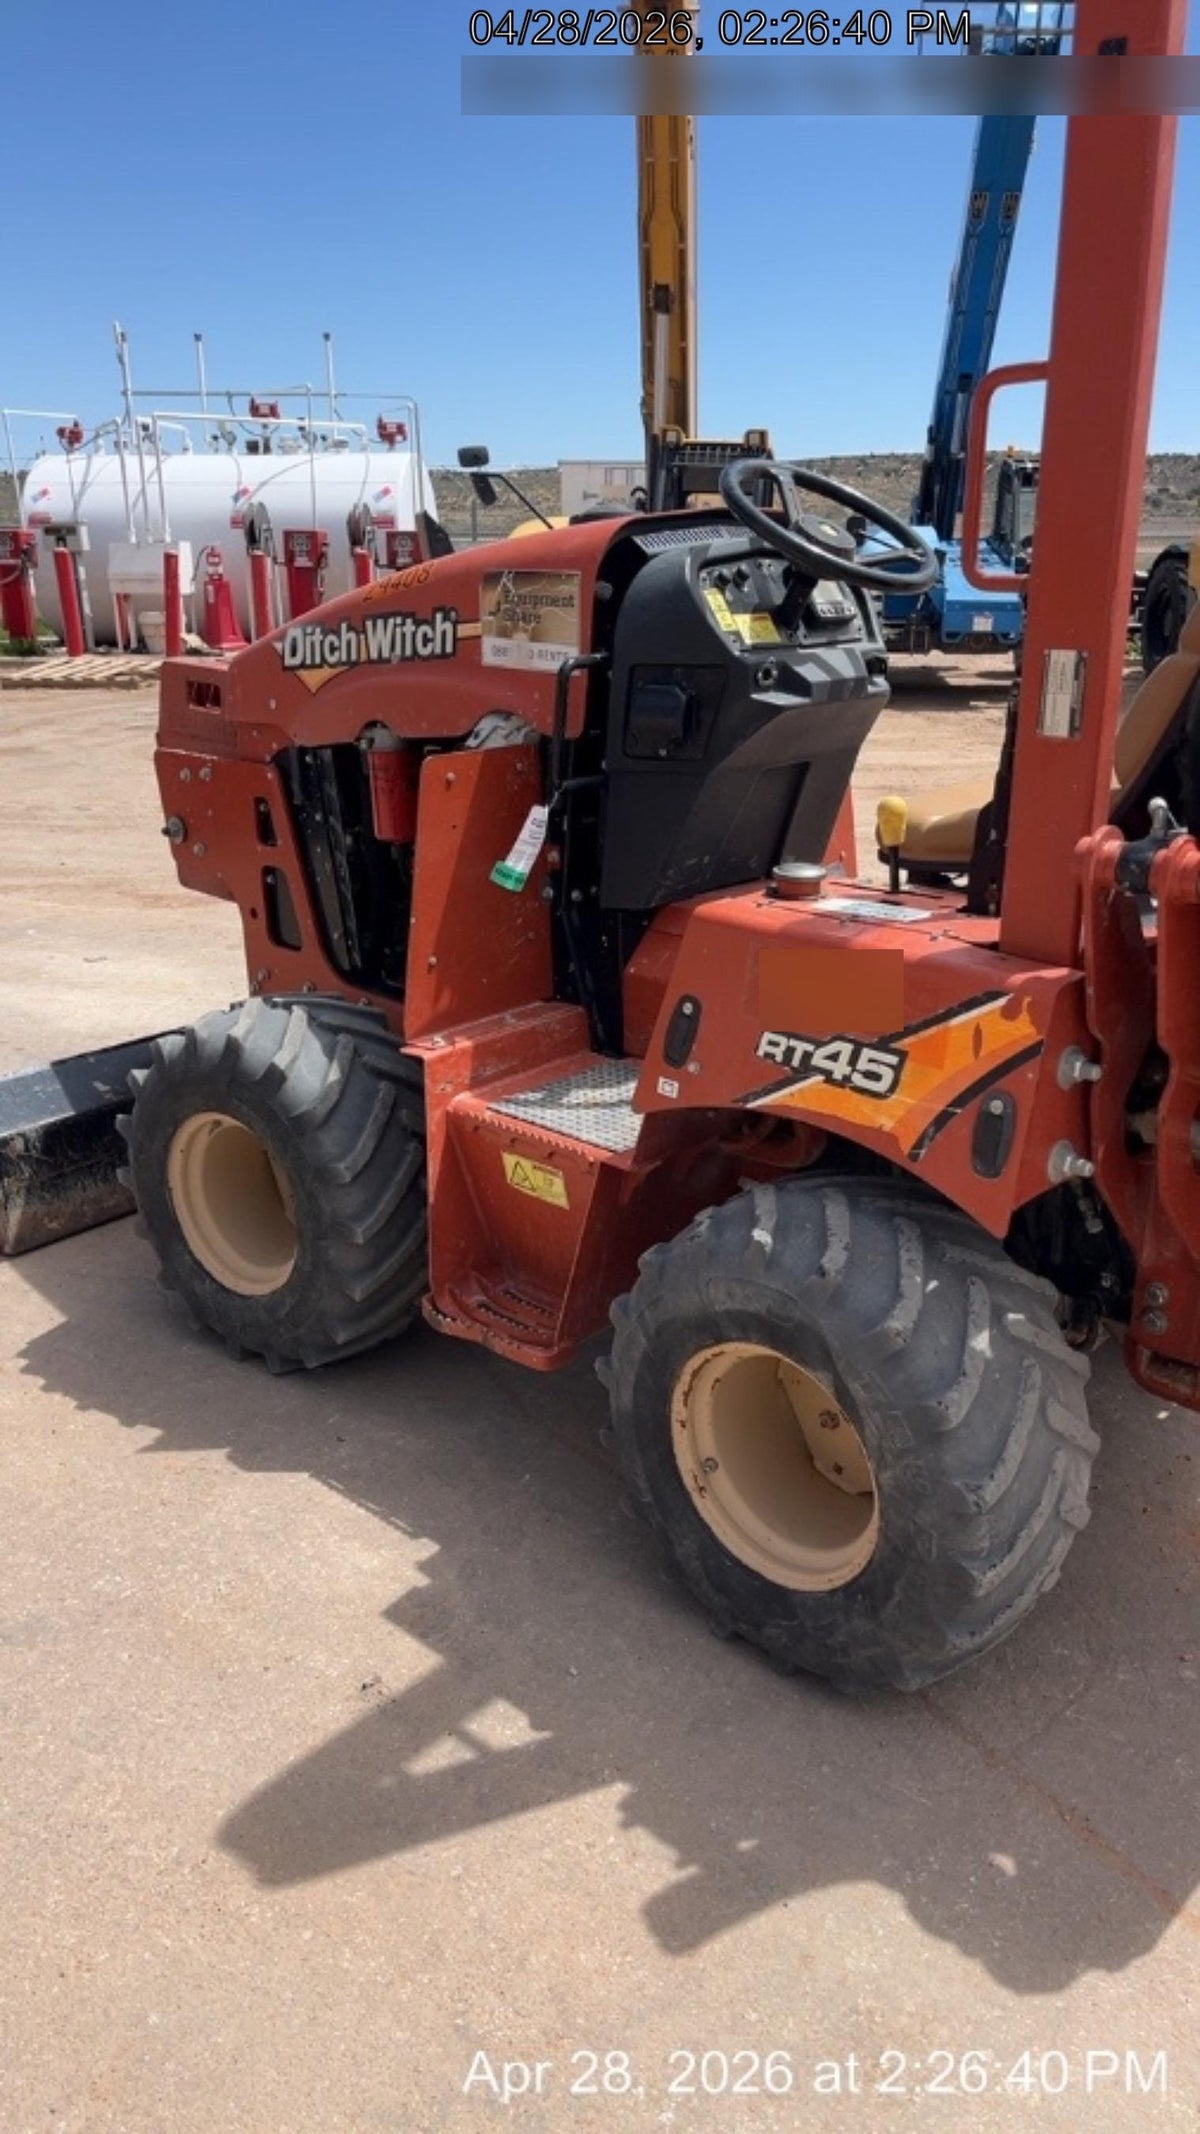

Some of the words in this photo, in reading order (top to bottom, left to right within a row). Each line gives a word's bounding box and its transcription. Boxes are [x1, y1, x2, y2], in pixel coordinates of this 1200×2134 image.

[501, 606, 542, 625] Share
[504, 588, 575, 609] Equipment
[284, 623, 357, 667] Ditch
[364, 609, 456, 660] Witch
[756, 1031, 900, 1094] RT45
